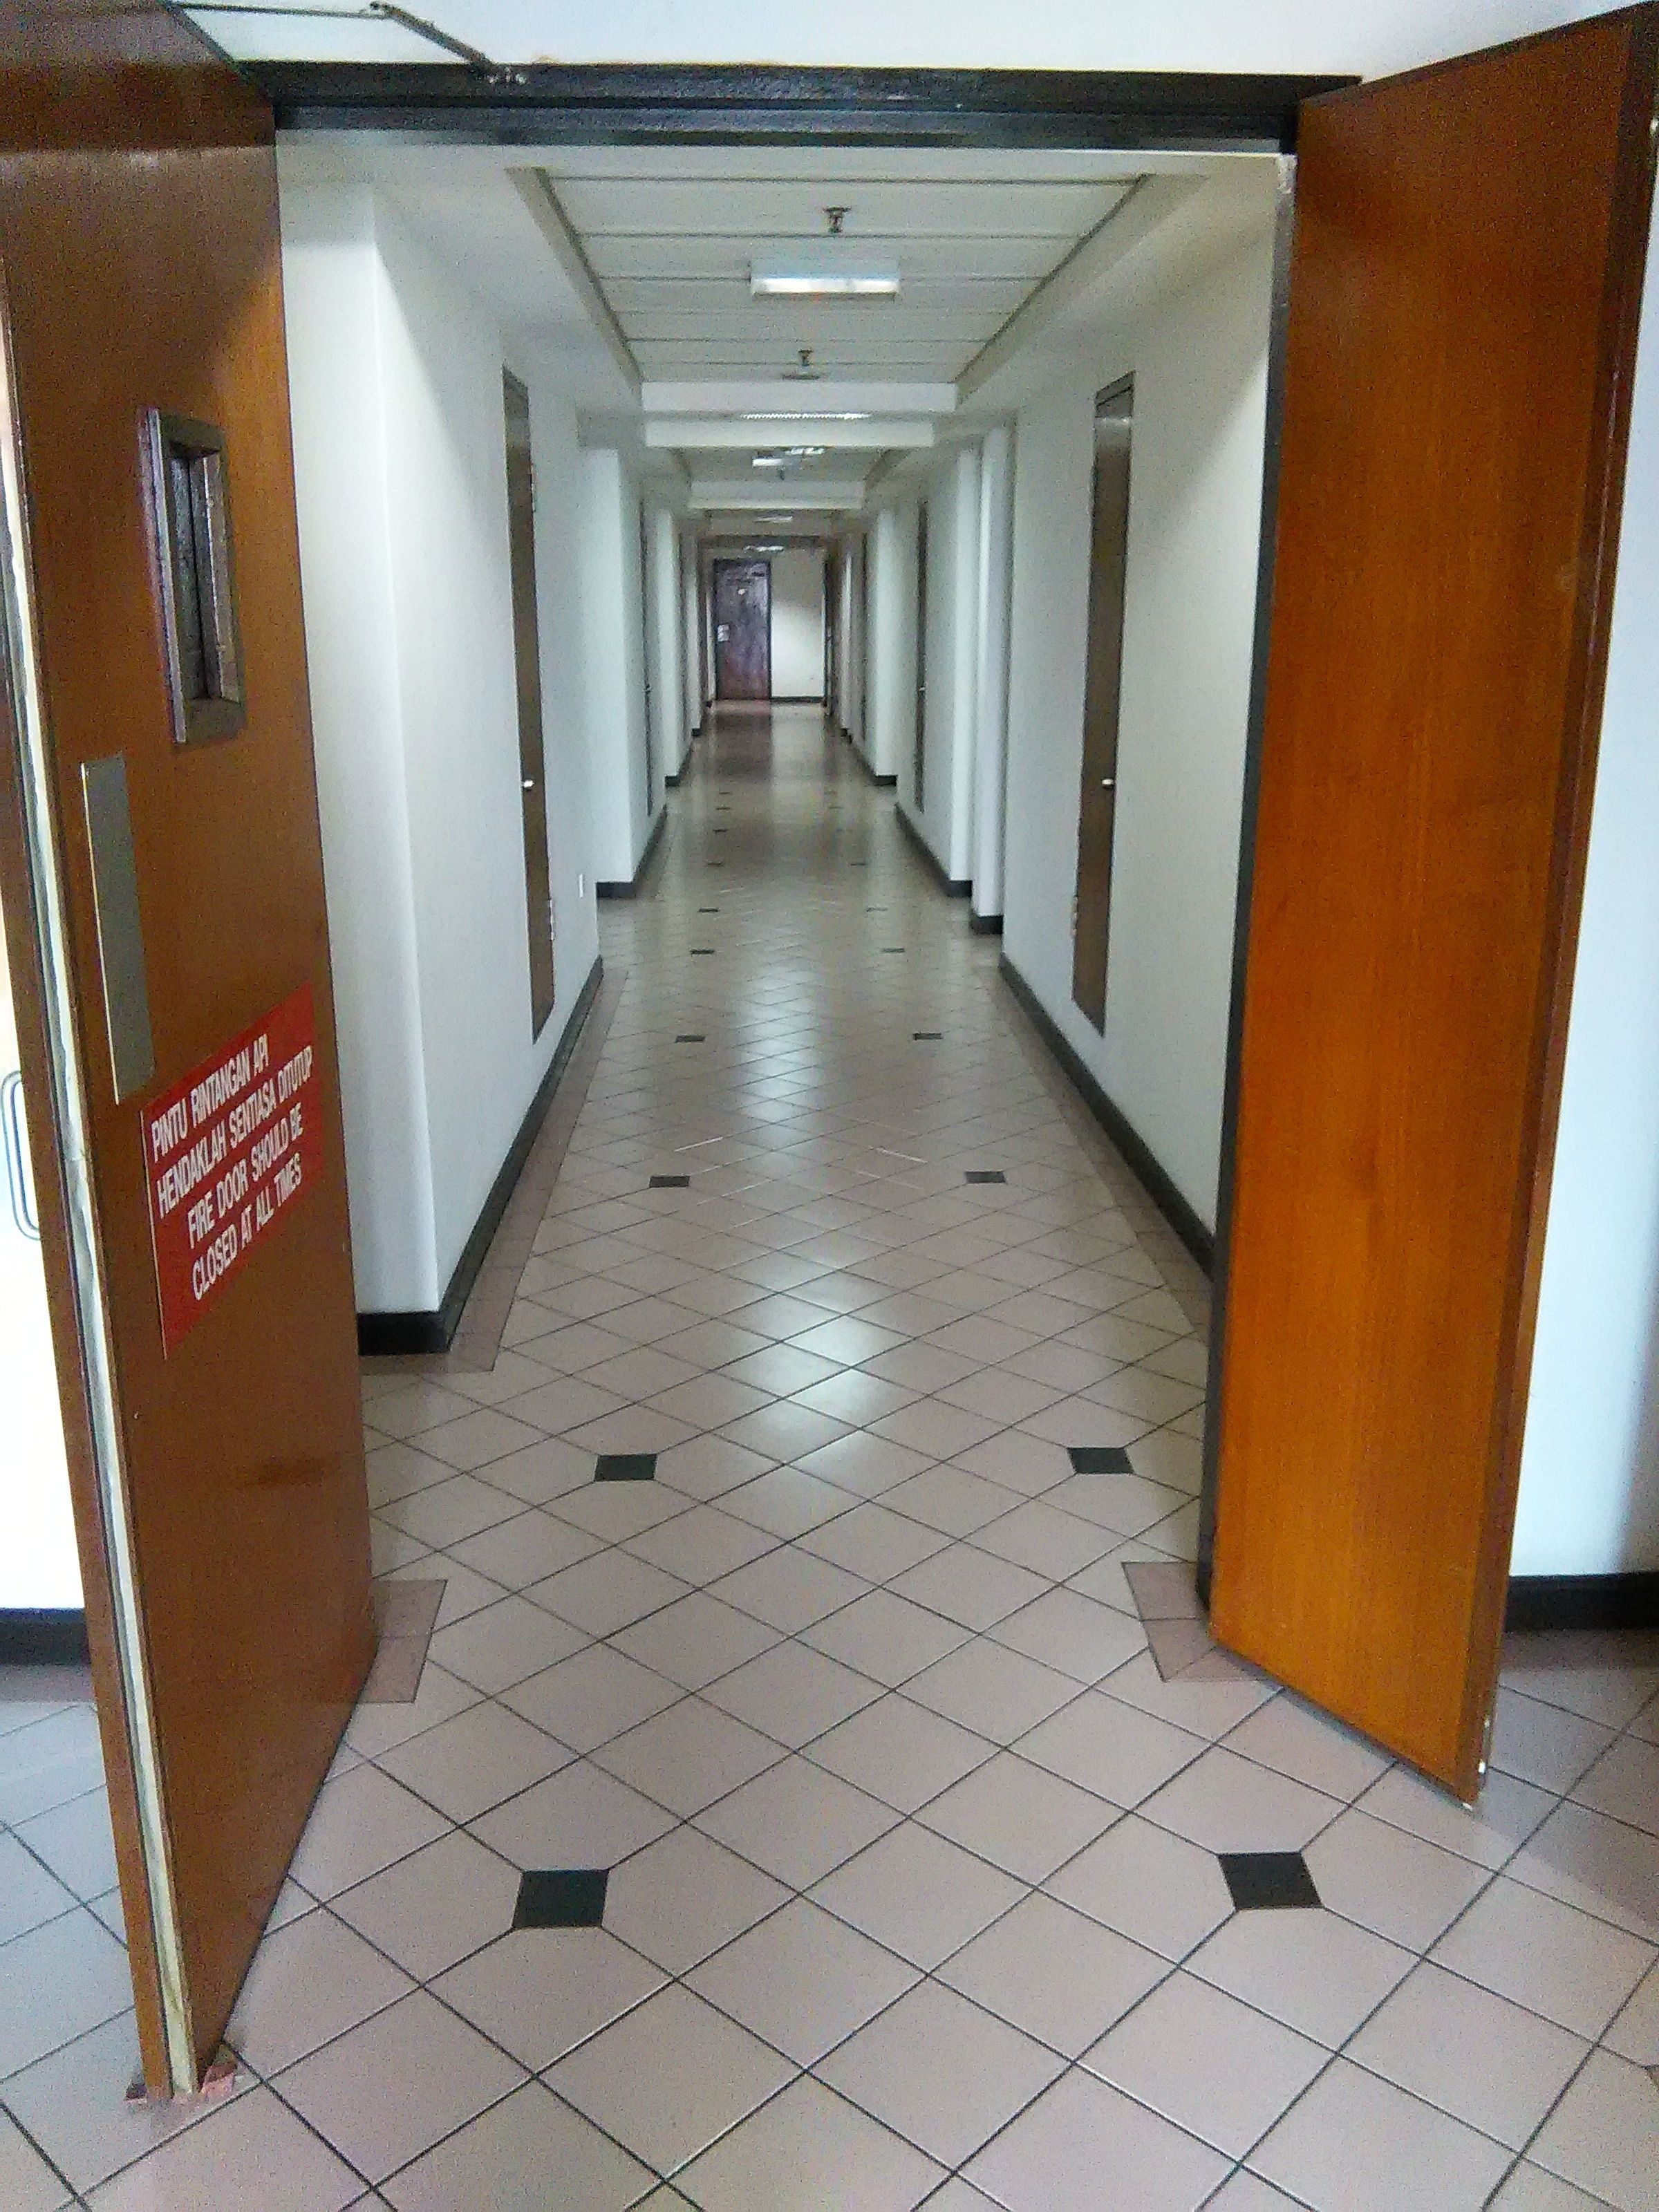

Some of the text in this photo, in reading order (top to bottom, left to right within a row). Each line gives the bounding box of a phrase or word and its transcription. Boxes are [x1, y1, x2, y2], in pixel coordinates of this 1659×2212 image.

[151, 1097, 188, 1163] PINTU
[190, 1046, 251, 1128] RINTANGAN
[157, 1044, 312, 1219] HENDAKLAH SENTIASA DITUTUP
[187, 1102, 303, 1249] FIRE DOOR SHOULD BE
[191, 1152, 302, 1300] CLOSED AT ALL TIMES
